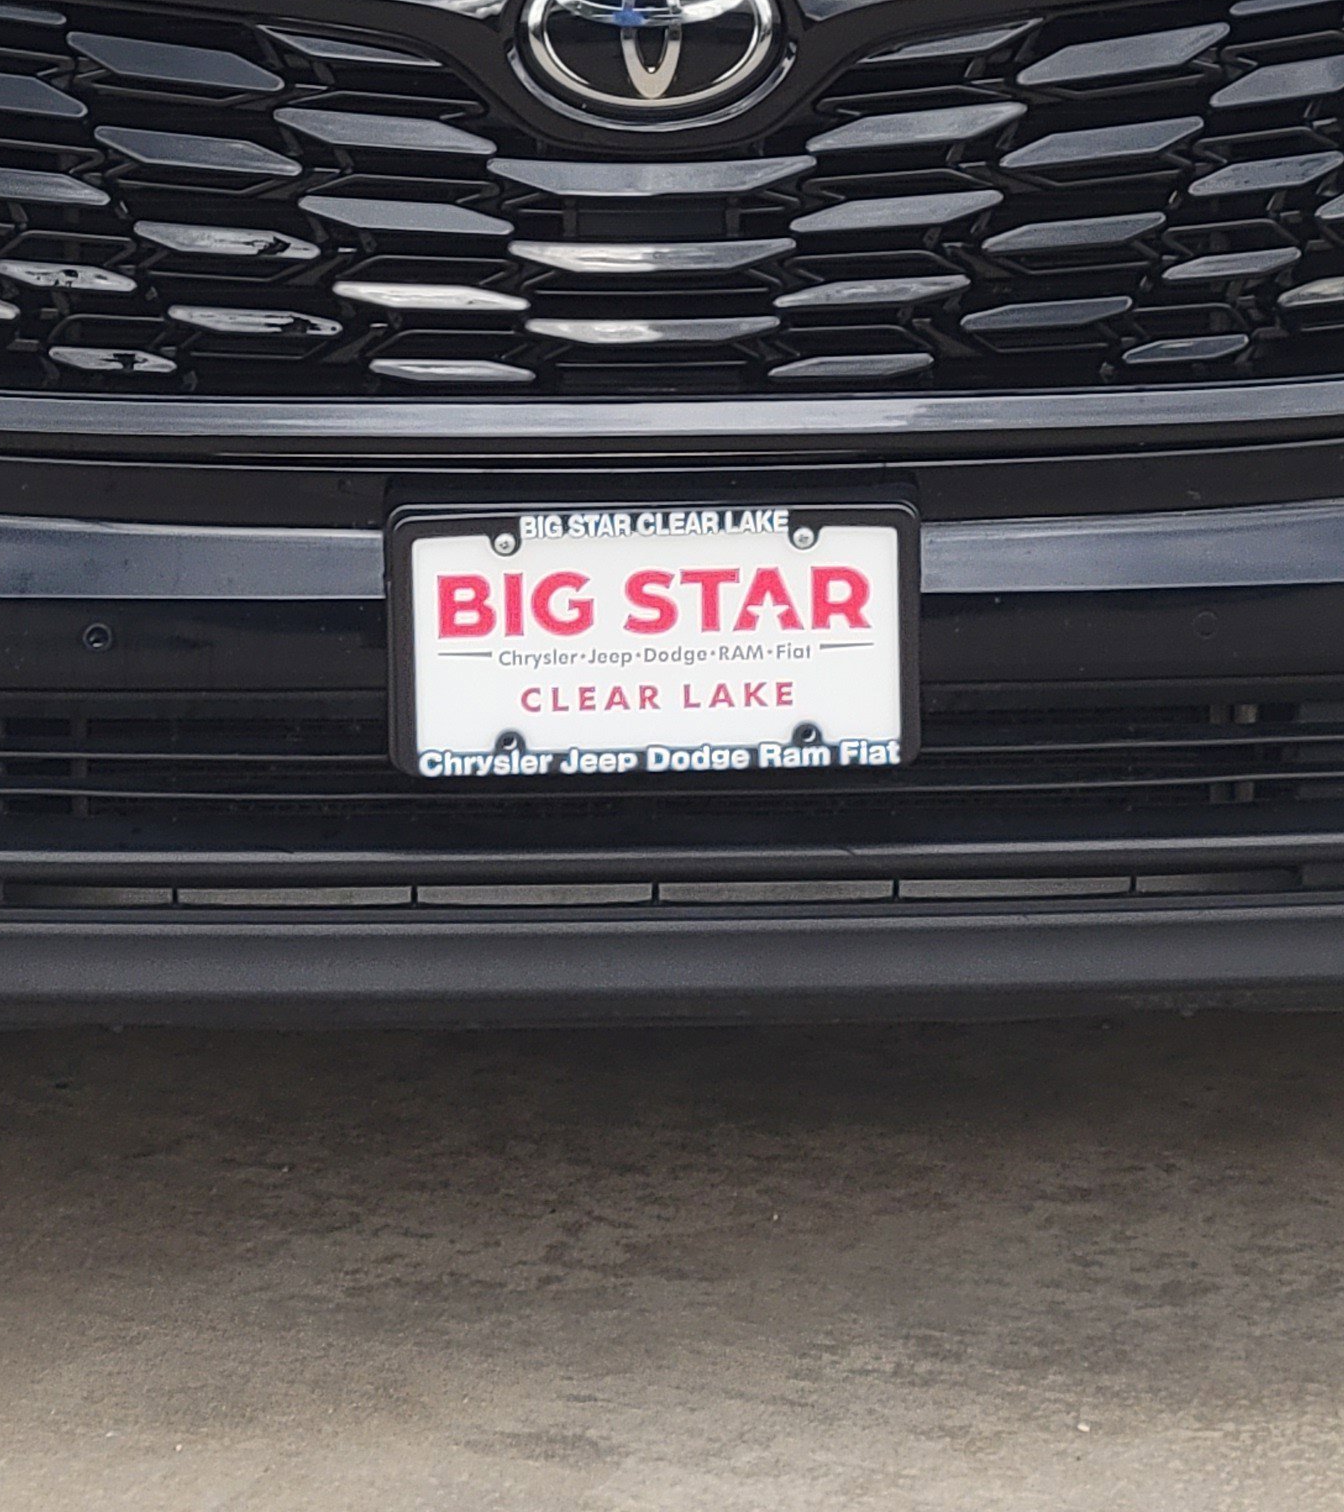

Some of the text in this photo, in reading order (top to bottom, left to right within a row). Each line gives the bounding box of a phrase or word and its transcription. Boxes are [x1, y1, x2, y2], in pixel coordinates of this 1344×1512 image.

[519, 509, 789, 538] BIG STAR CLEAR LAKE
[438, 566, 873, 639] BIG STAR
[520, 681, 794, 713] CLEAR LAKE
[418, 739, 901, 778] Chrysler Jeep Dodge Ram Fiat
